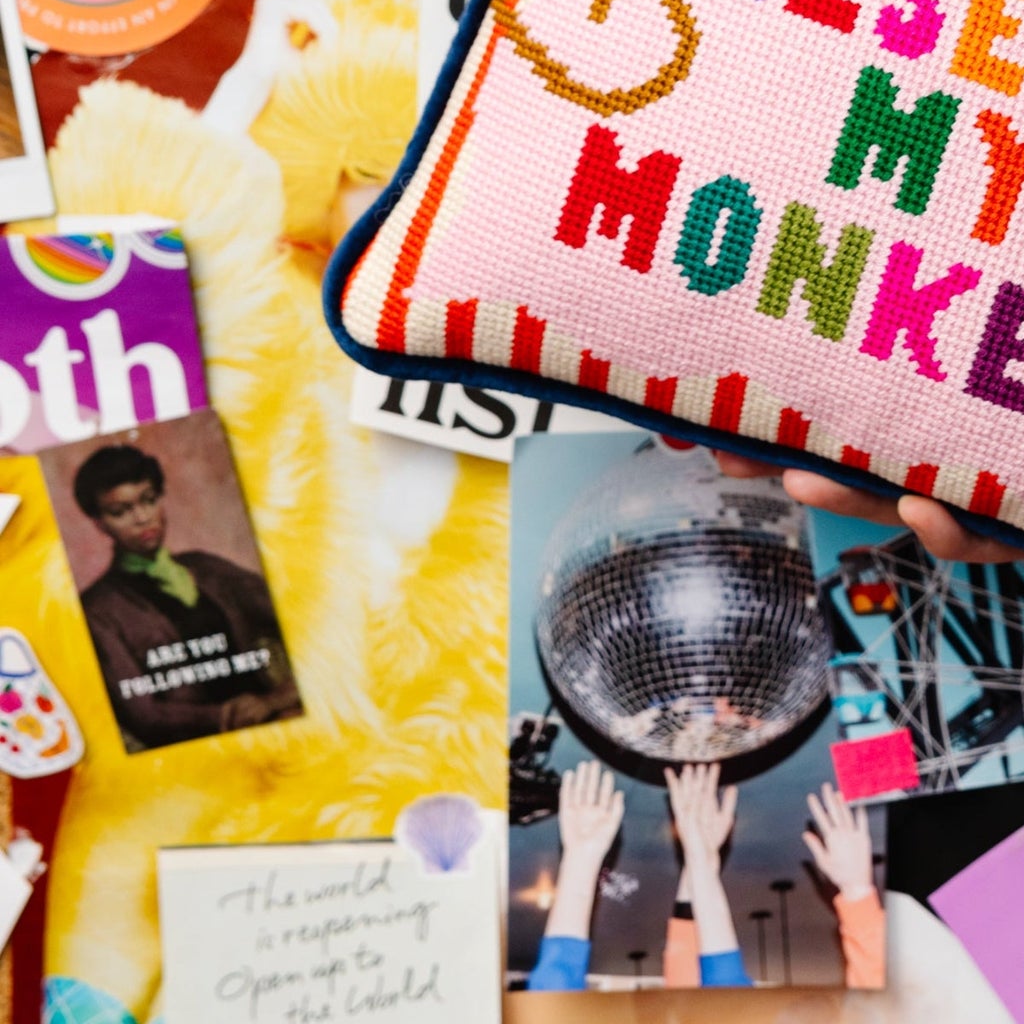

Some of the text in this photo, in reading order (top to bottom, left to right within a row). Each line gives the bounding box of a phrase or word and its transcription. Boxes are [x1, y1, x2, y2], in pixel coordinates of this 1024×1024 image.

[146, 632, 229, 669] ARE YOU
[118, 657, 232, 700] FOLLOWING
